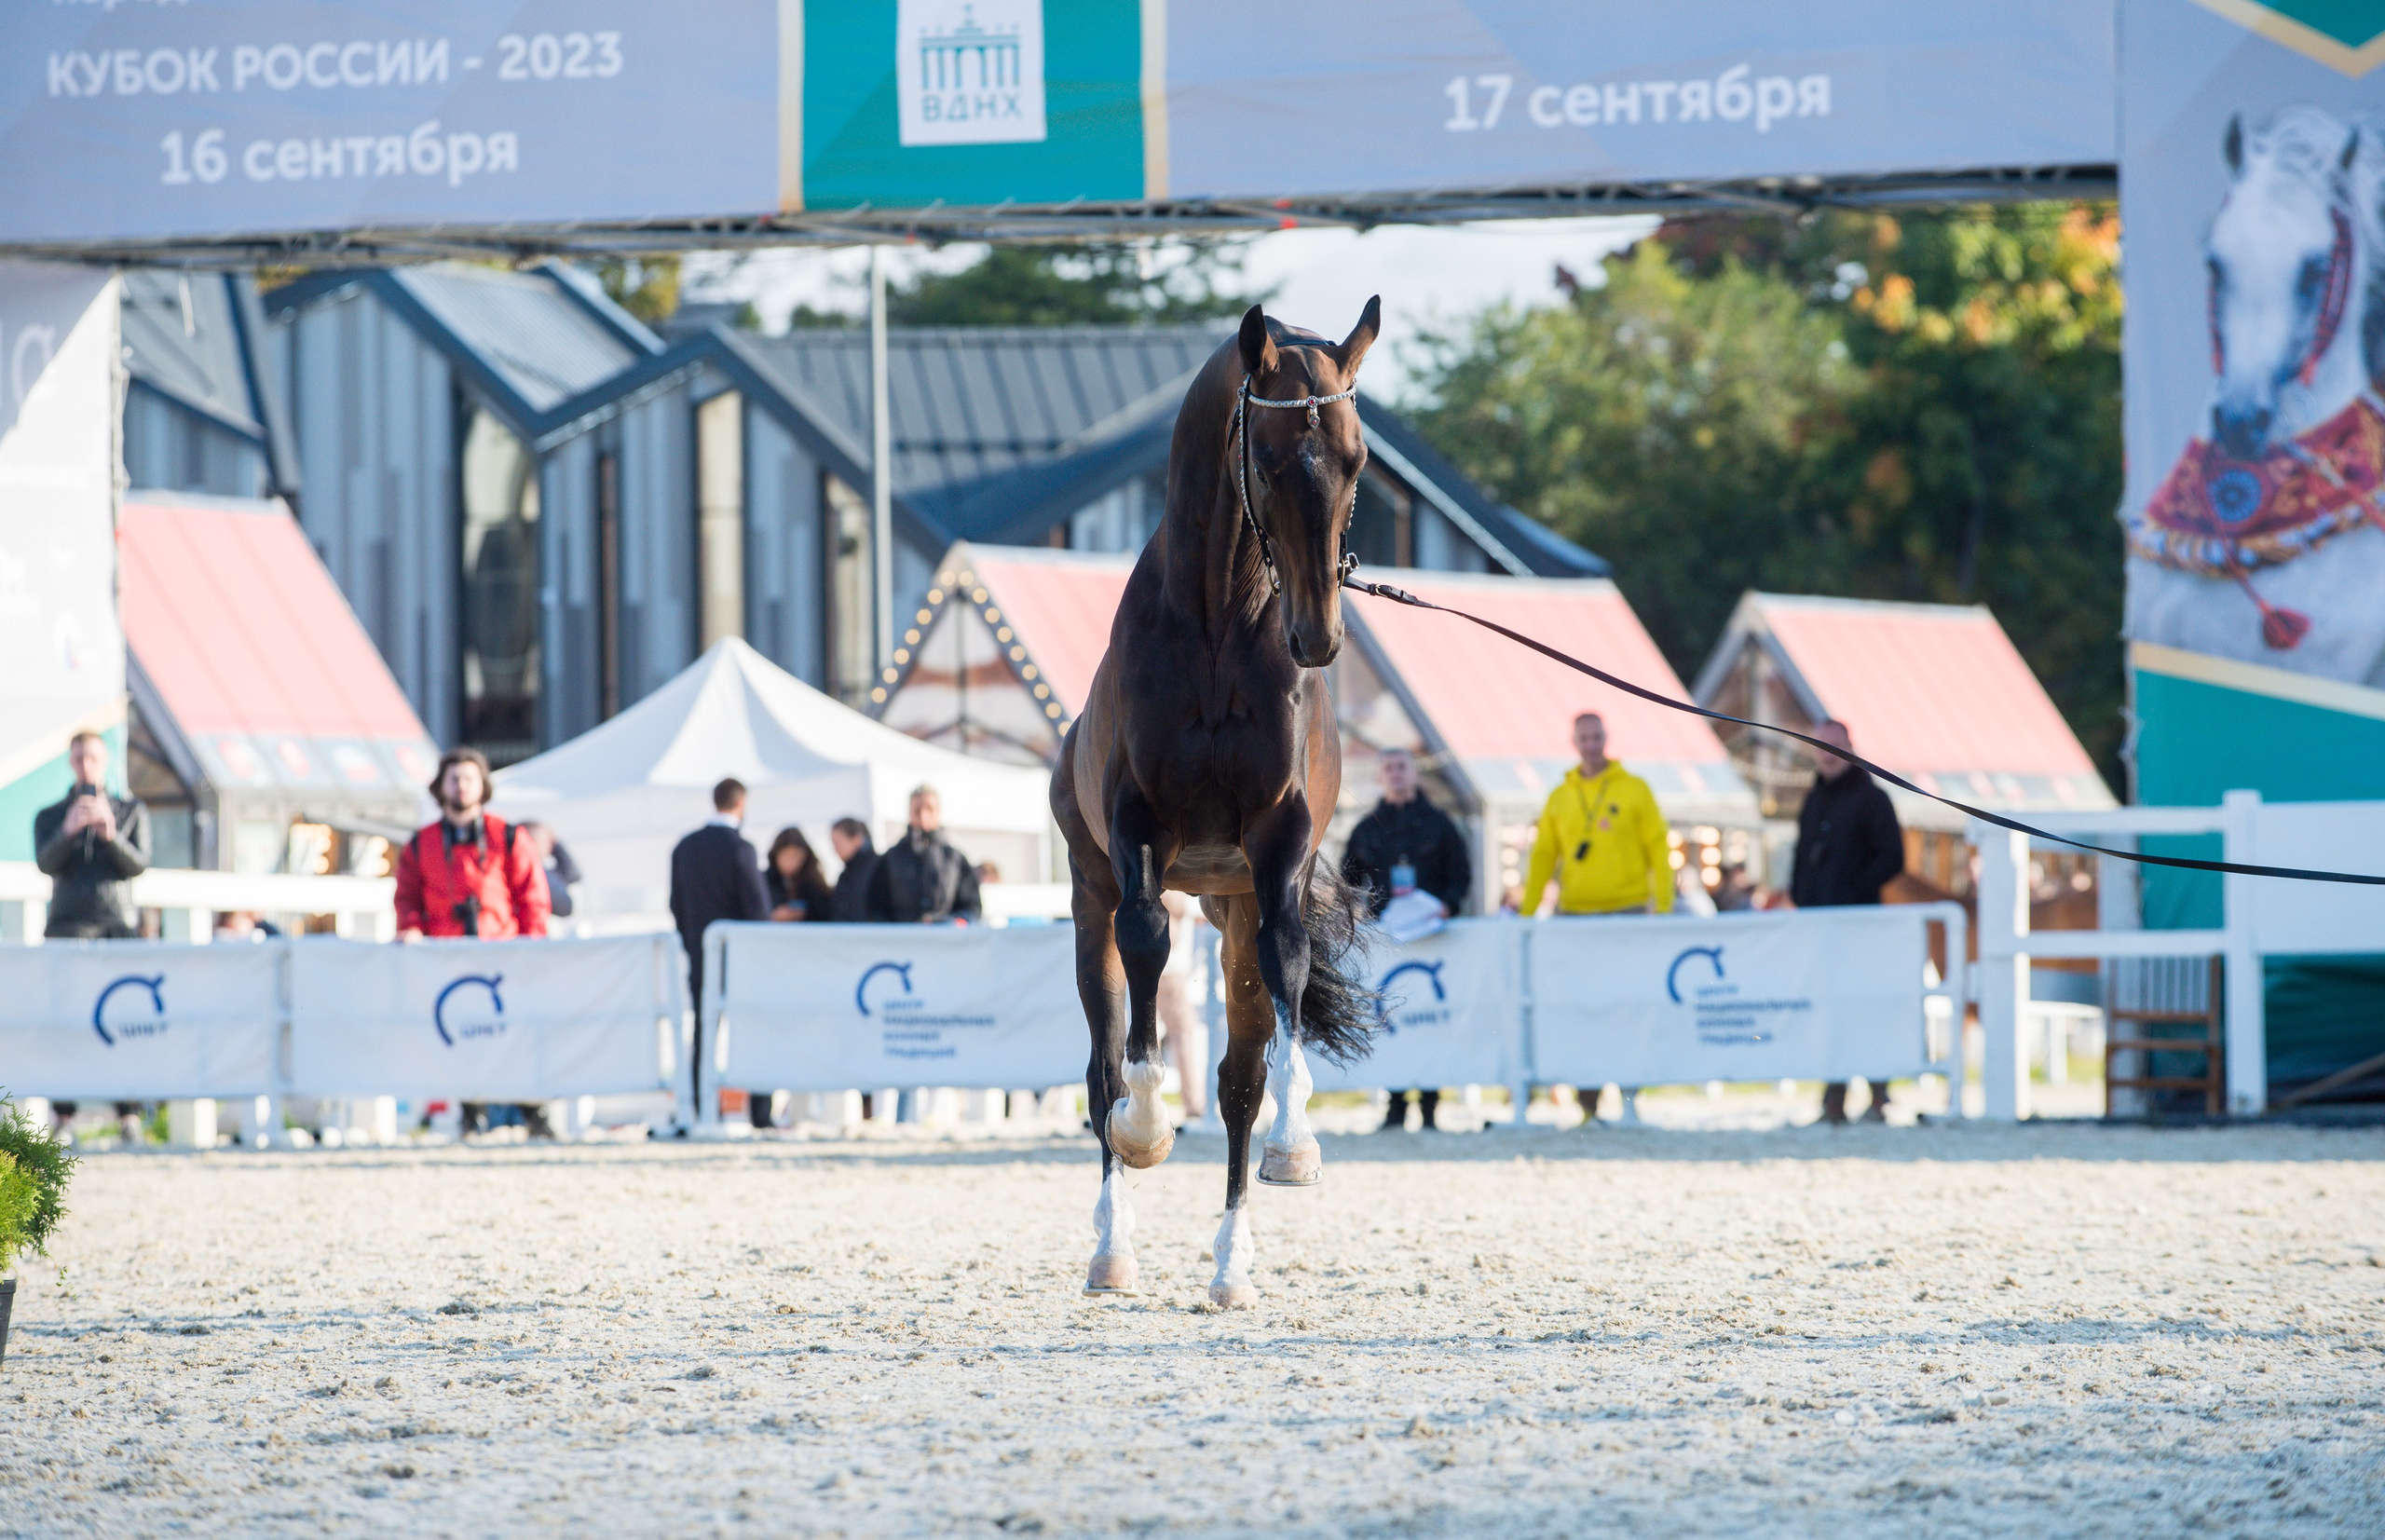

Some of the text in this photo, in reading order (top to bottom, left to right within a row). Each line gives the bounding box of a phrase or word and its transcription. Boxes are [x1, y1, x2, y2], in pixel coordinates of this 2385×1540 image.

[47, 48, 220, 97] КУБОК
[232, 39, 450, 91] РОССИИ
[497, 33, 623, 80] 2023
[921, 95, 1023, 122] ВДНХ
[1445, 63, 1833, 132] 17 сентября
[160, 122, 519, 186] 16 сентября
